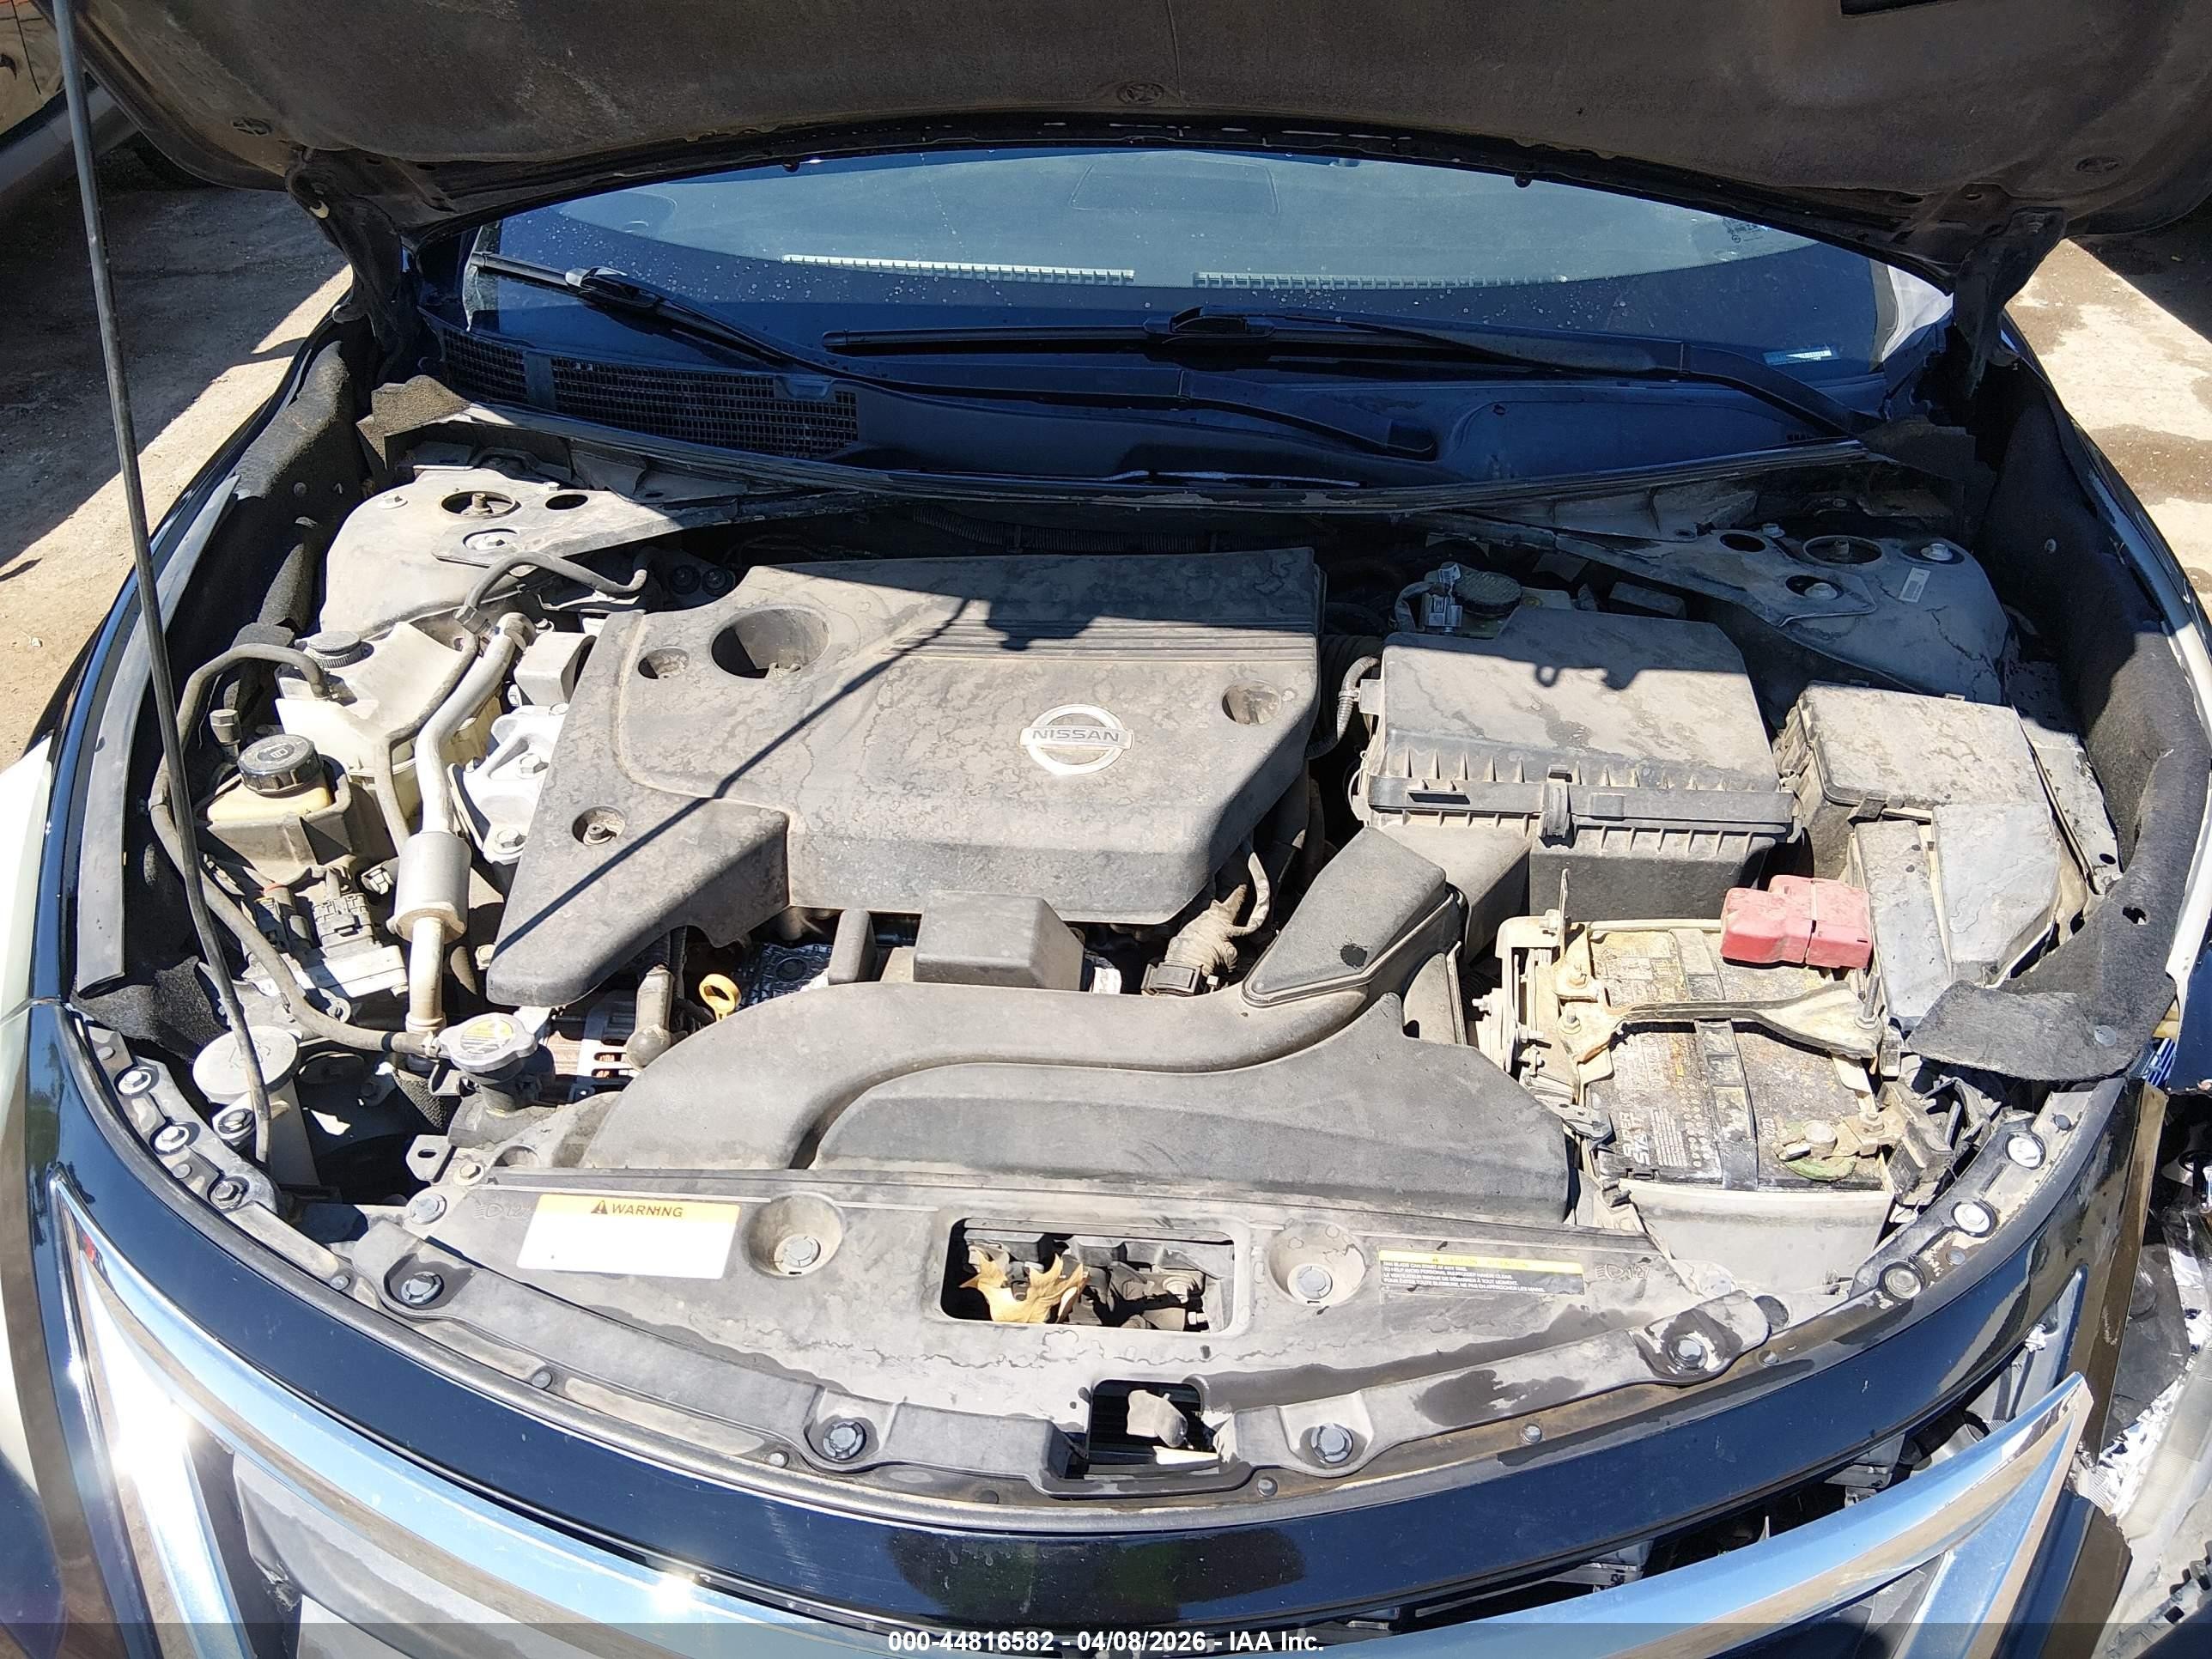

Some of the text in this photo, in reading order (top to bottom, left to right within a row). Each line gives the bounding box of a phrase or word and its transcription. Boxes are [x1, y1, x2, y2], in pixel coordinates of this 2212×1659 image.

[1032, 729, 1120, 742] NISSAN
[1619, 1110, 1634, 1158] SUPER
[612, 1203, 684, 1218] WARNING
